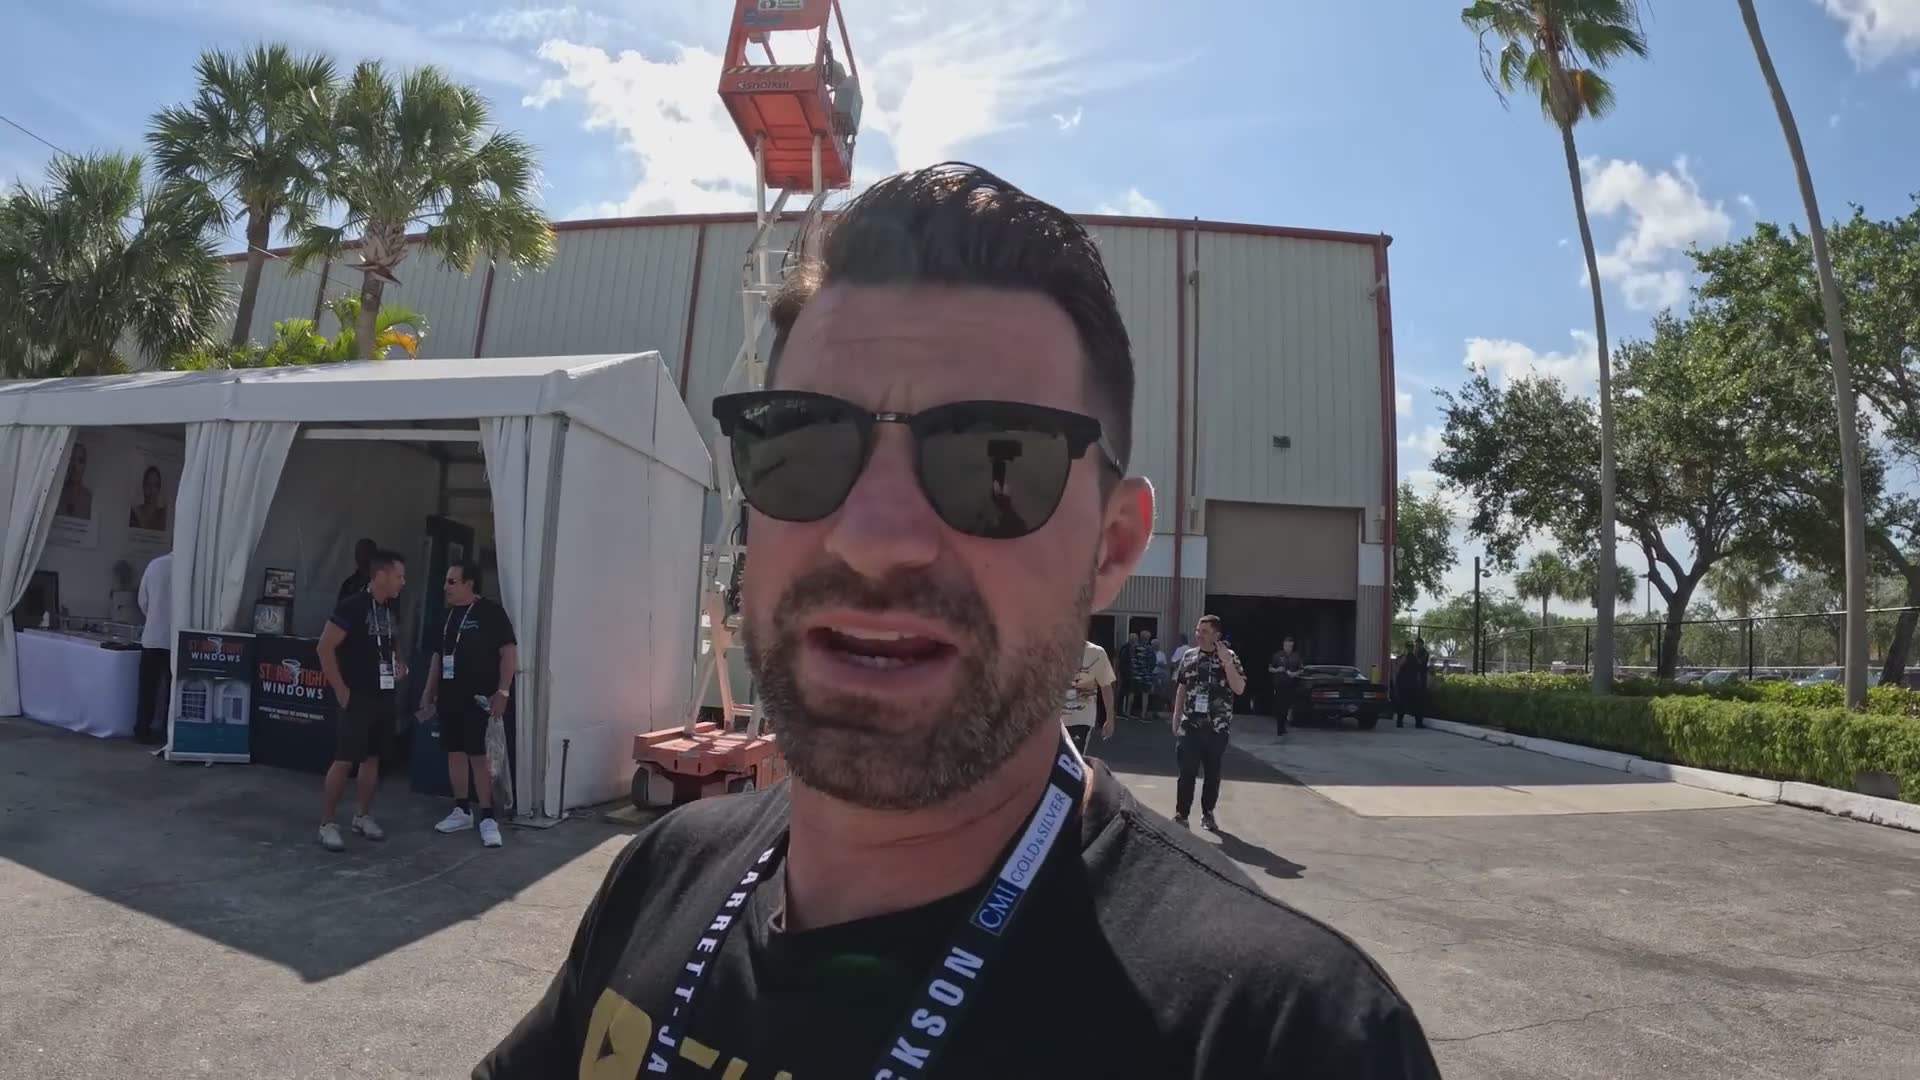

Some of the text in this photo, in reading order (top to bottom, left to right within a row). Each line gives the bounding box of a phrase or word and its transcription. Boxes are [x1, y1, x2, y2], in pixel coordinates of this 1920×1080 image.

[191, 650, 241, 662] WINDOWS
[262, 680, 323, 700] WINDOWS
[979, 884, 1017, 928] CMI
